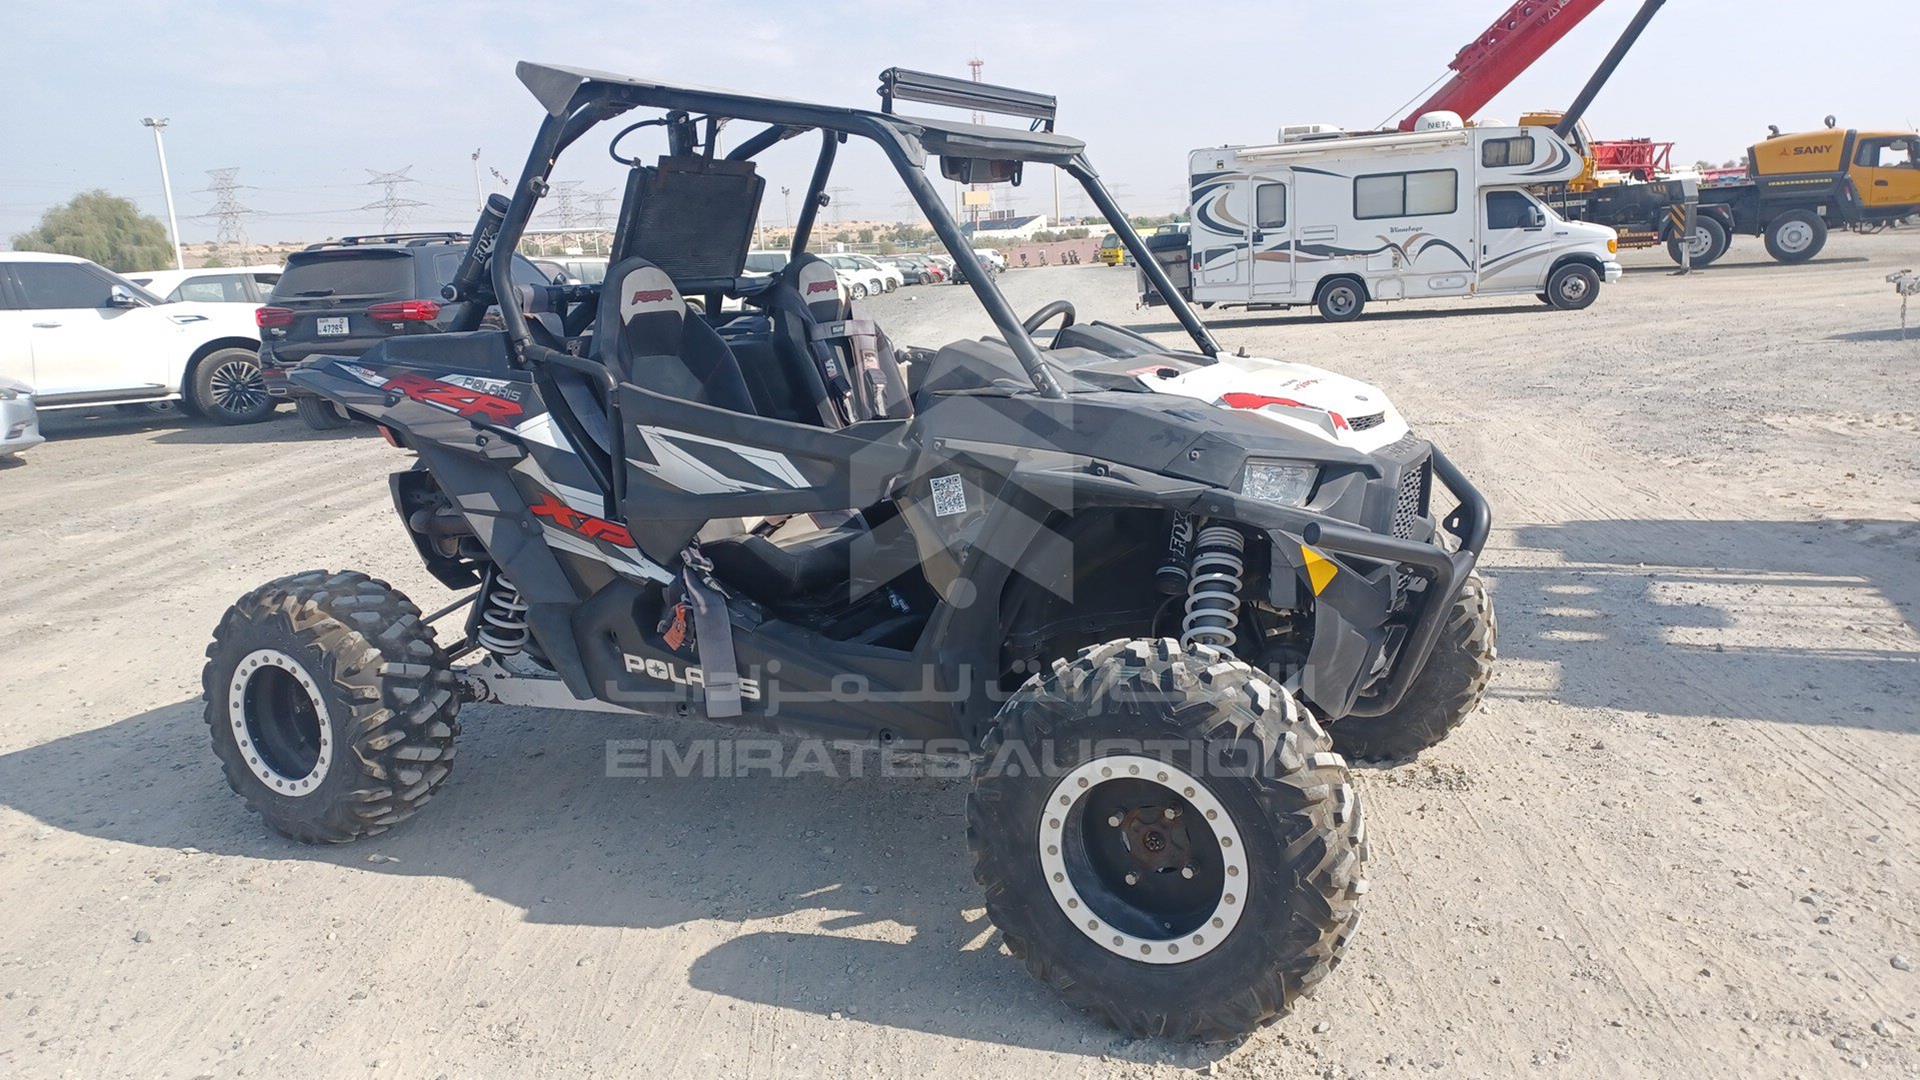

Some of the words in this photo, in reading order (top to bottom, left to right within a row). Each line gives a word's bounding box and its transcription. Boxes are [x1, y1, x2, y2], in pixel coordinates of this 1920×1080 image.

[1793, 145, 1832, 156] SANY
[381, 373, 524, 427] RZR
[462, 376, 522, 402] POLARIS
[529, 492, 638, 549] XP
[1169, 509, 1194, 557] FOX
[623, 653, 761, 700] POLAS
